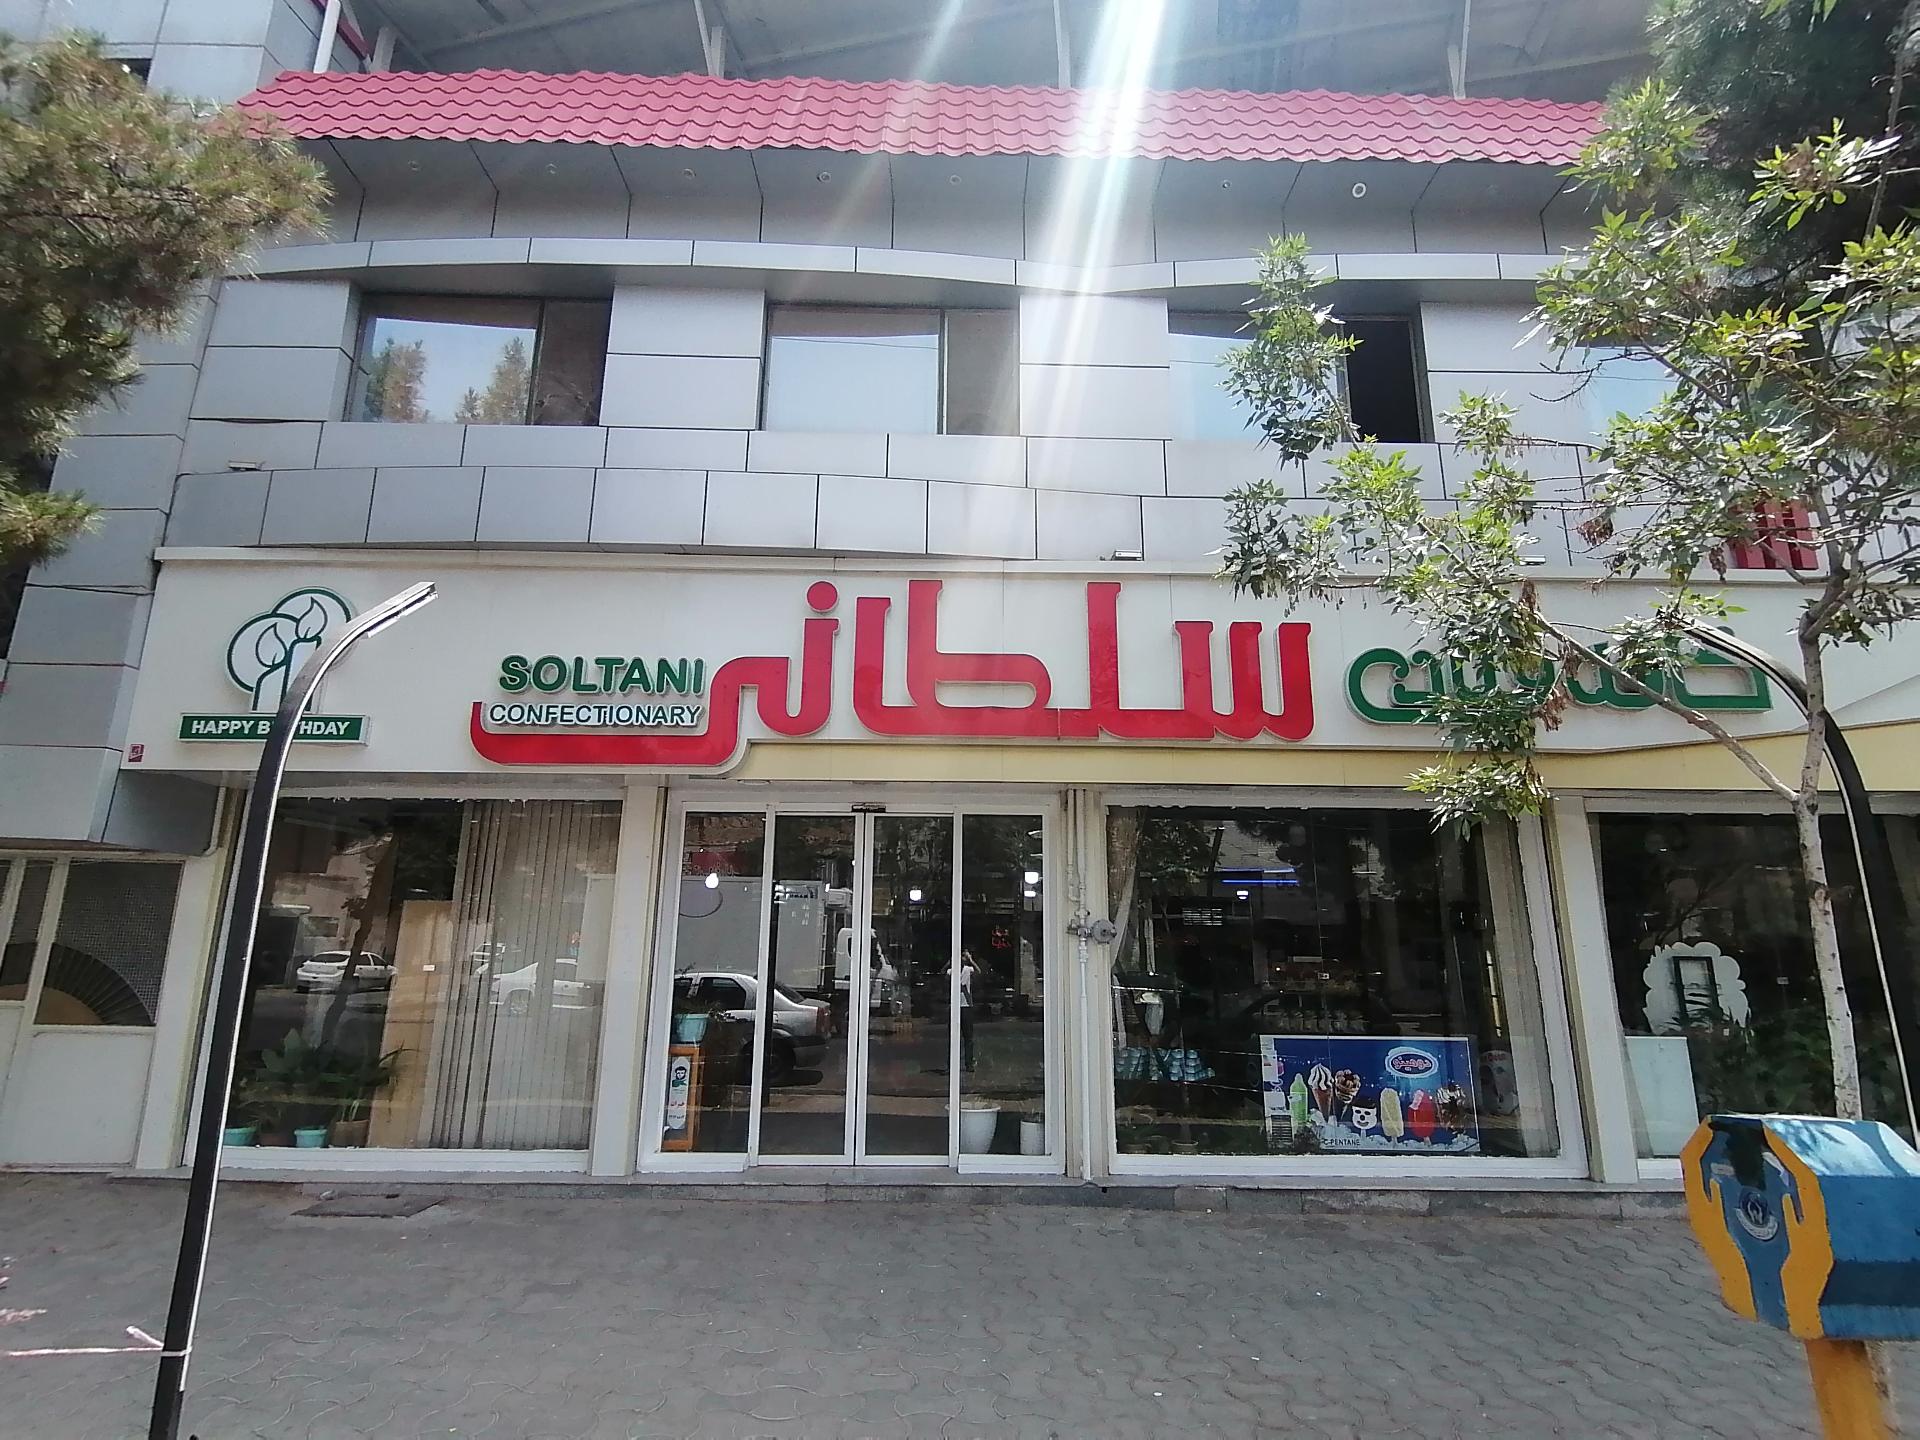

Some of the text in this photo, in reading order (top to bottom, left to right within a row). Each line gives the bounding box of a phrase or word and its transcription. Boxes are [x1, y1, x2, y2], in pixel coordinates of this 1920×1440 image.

[470, 579, 1312, 764] سلطانی
[500, 655, 705, 694] SOLTANI
[191, 720, 351, 736] HAPPY BHDAY
[489, 703, 702, 725] CONFECTIONARY
